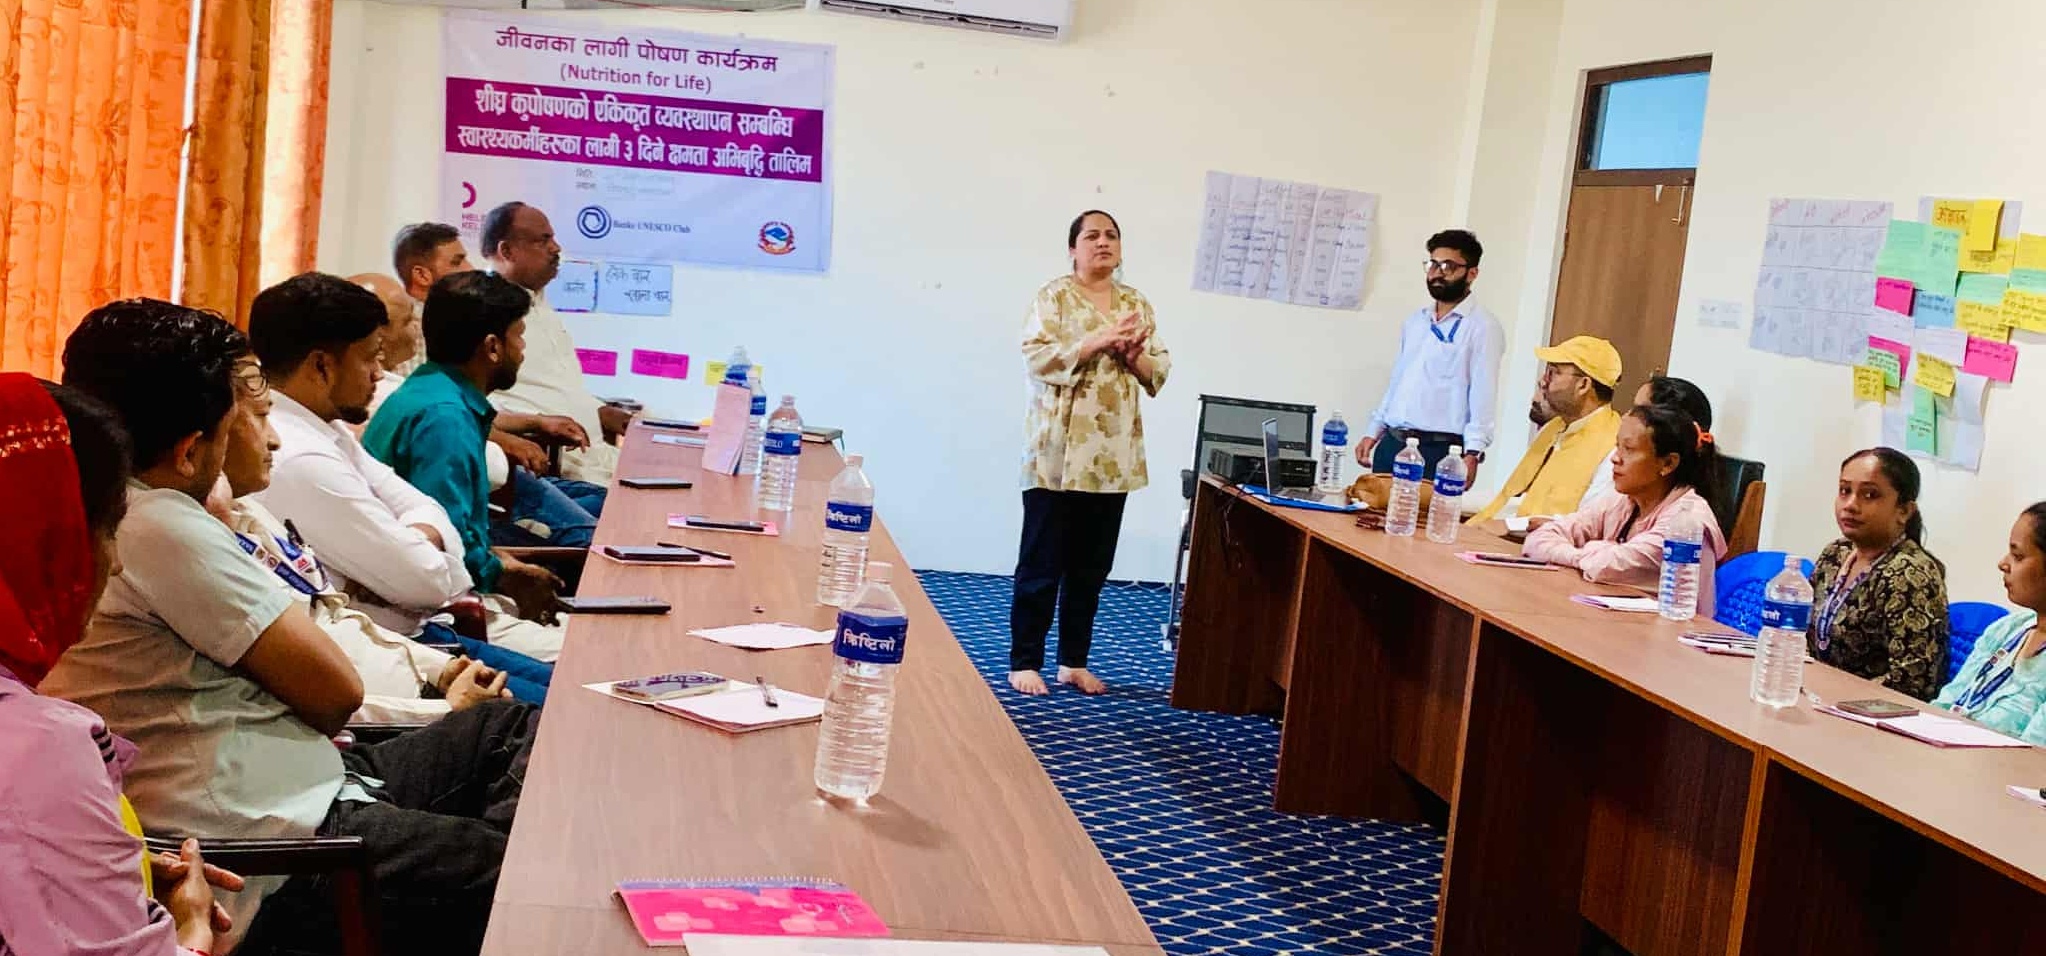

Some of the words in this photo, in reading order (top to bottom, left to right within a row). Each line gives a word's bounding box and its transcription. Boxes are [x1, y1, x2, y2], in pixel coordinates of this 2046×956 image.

[495, 26, 576, 54] जीवनका
[583, 36, 630, 58] लागी
[637, 39, 690, 64] पोषण
[697, 49, 779, 72] कार्यक्रम
[560, 63, 641, 85] (Nutrition
[647, 71, 670, 87] for
[675, 74, 712, 94] Life)
[511, 87, 590, 121] कुपोषणको
[655, 105, 734, 133] व्यवस्थापन
[585, 132, 620, 159] लागी
[623, 140, 633, 162] ३
[638, 134, 664, 162] दिने
[668, 144, 709, 166] क्षमता
[768, 147, 813, 174] तालिम
